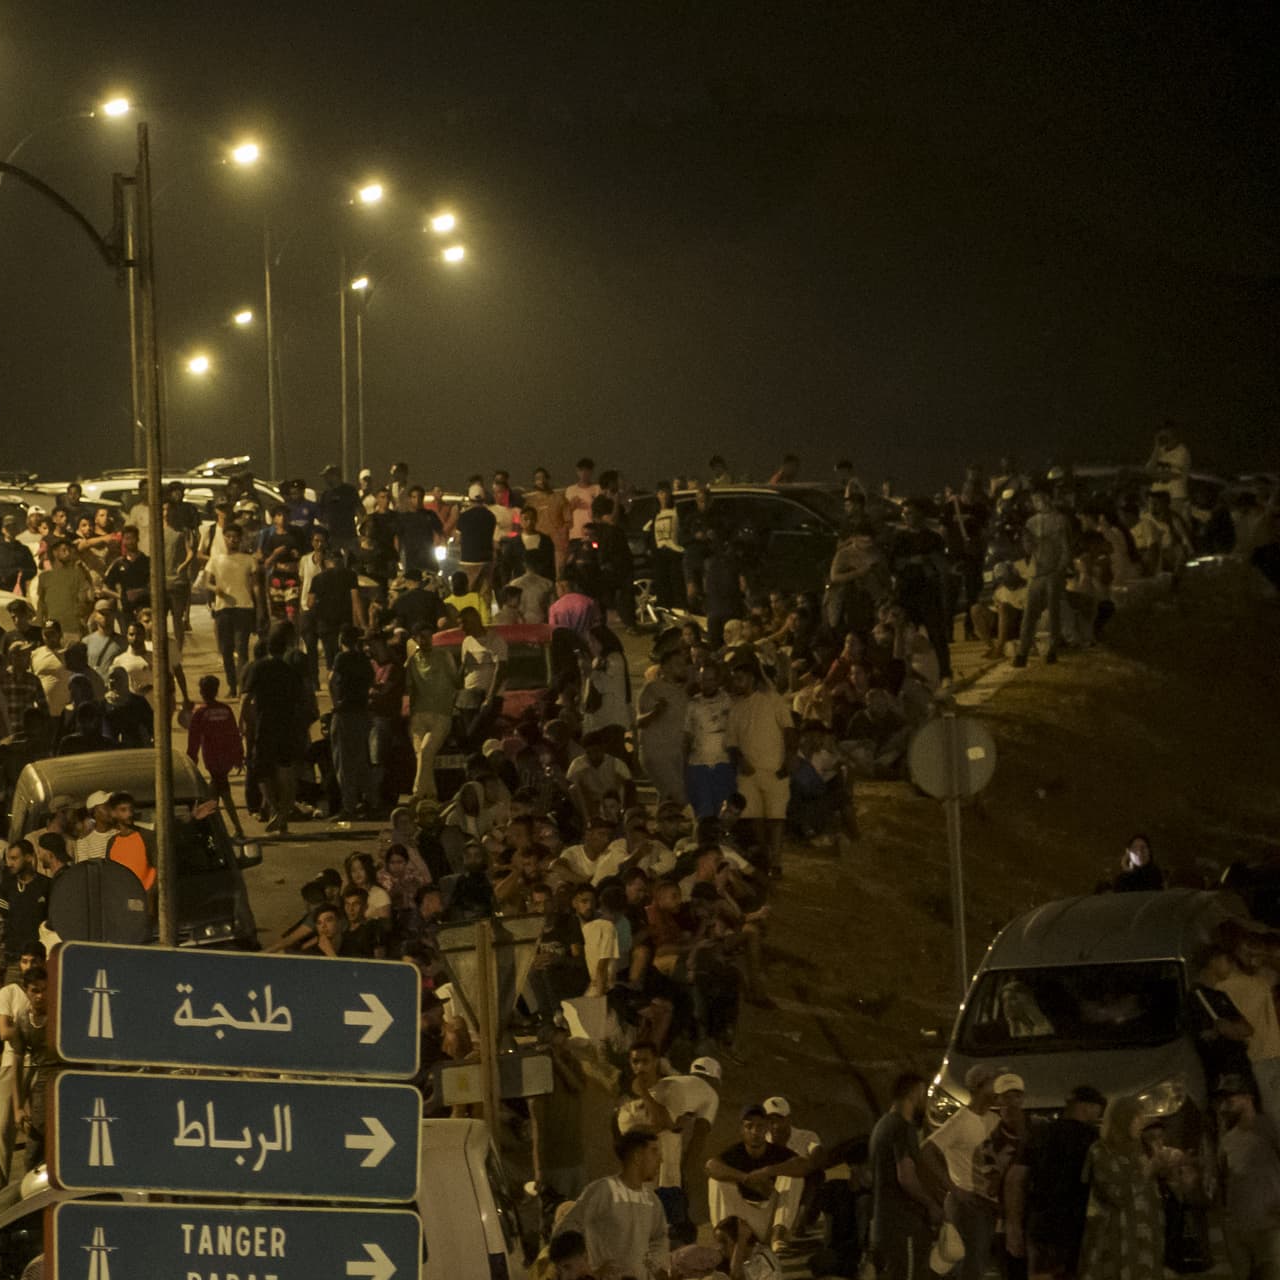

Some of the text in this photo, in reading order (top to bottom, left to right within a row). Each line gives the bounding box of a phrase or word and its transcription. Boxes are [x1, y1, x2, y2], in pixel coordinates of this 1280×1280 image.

[173, 983, 292, 1039] طنجة
[173, 1100, 292, 1172] الرباط
[181, 1223, 286, 1257] TANGER
